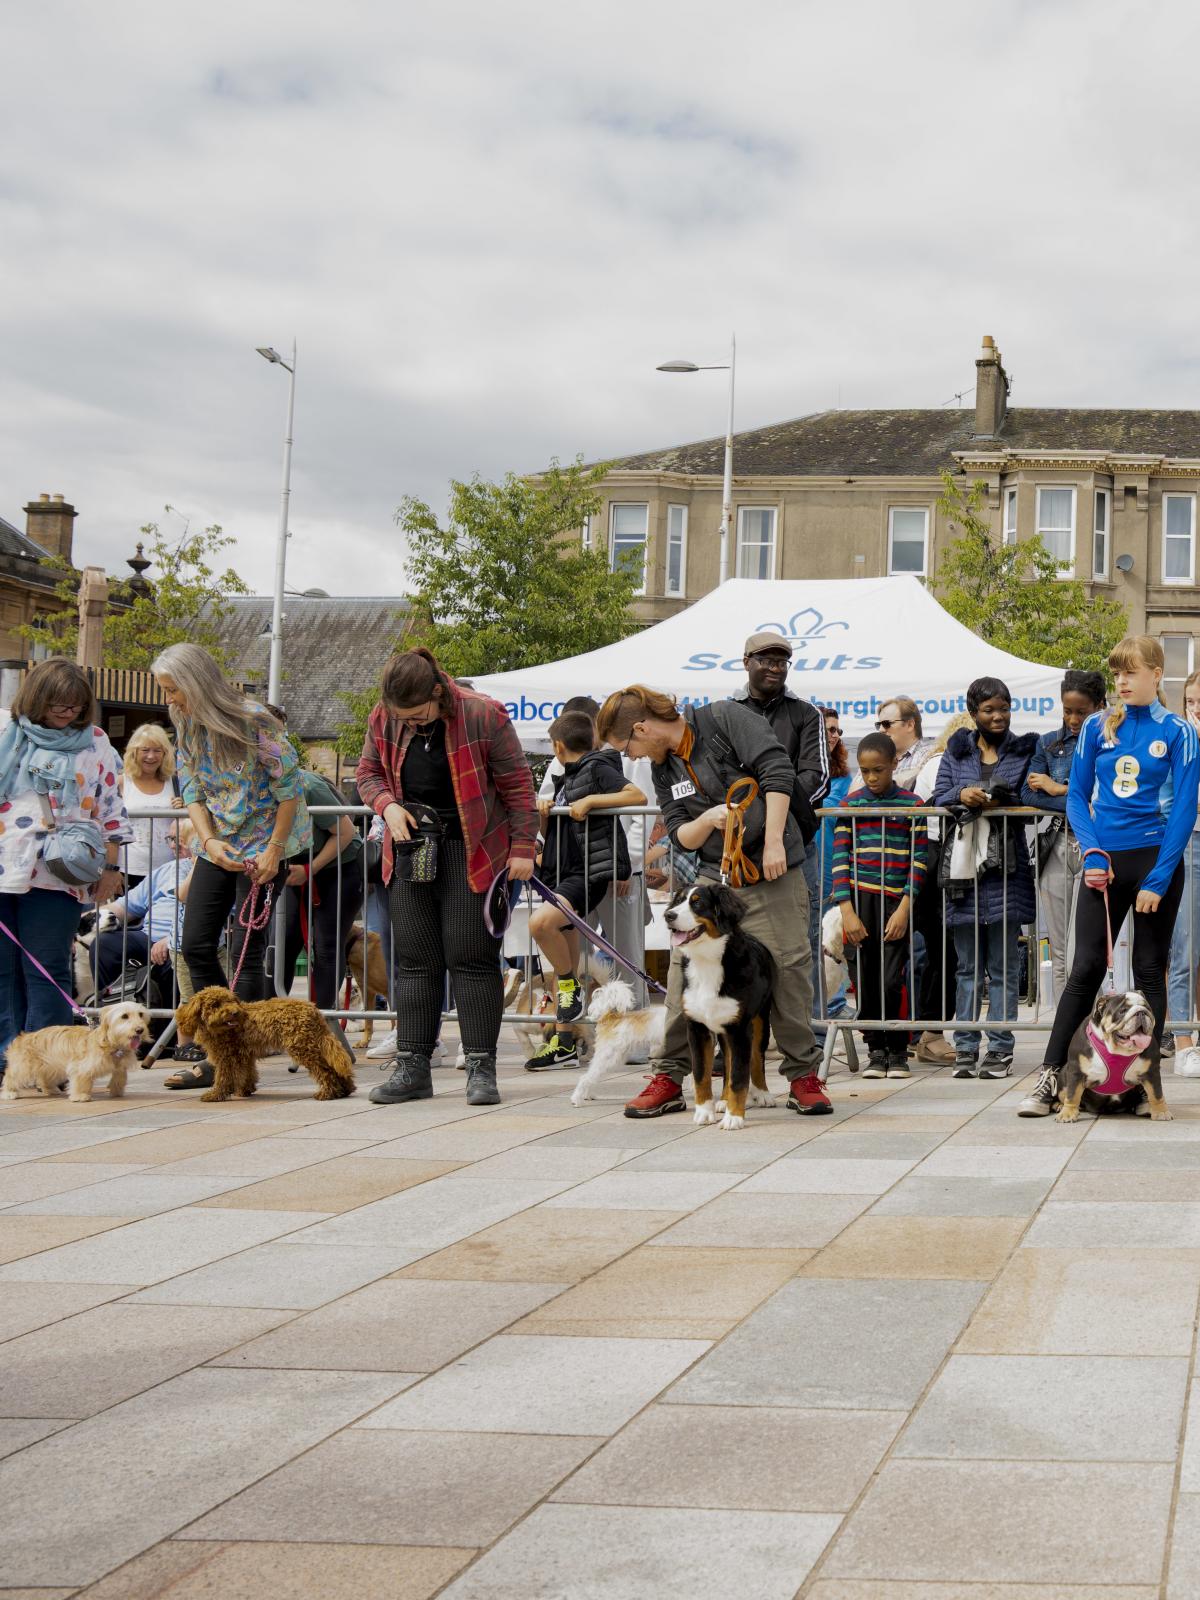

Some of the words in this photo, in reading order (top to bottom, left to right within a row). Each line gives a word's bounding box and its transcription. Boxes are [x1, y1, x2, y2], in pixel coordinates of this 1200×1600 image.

[681, 653, 883, 671] Scuts
[918, 695, 967, 714] cout
[1010, 697, 1054, 716] oup
[674, 782, 694, 797] 109
